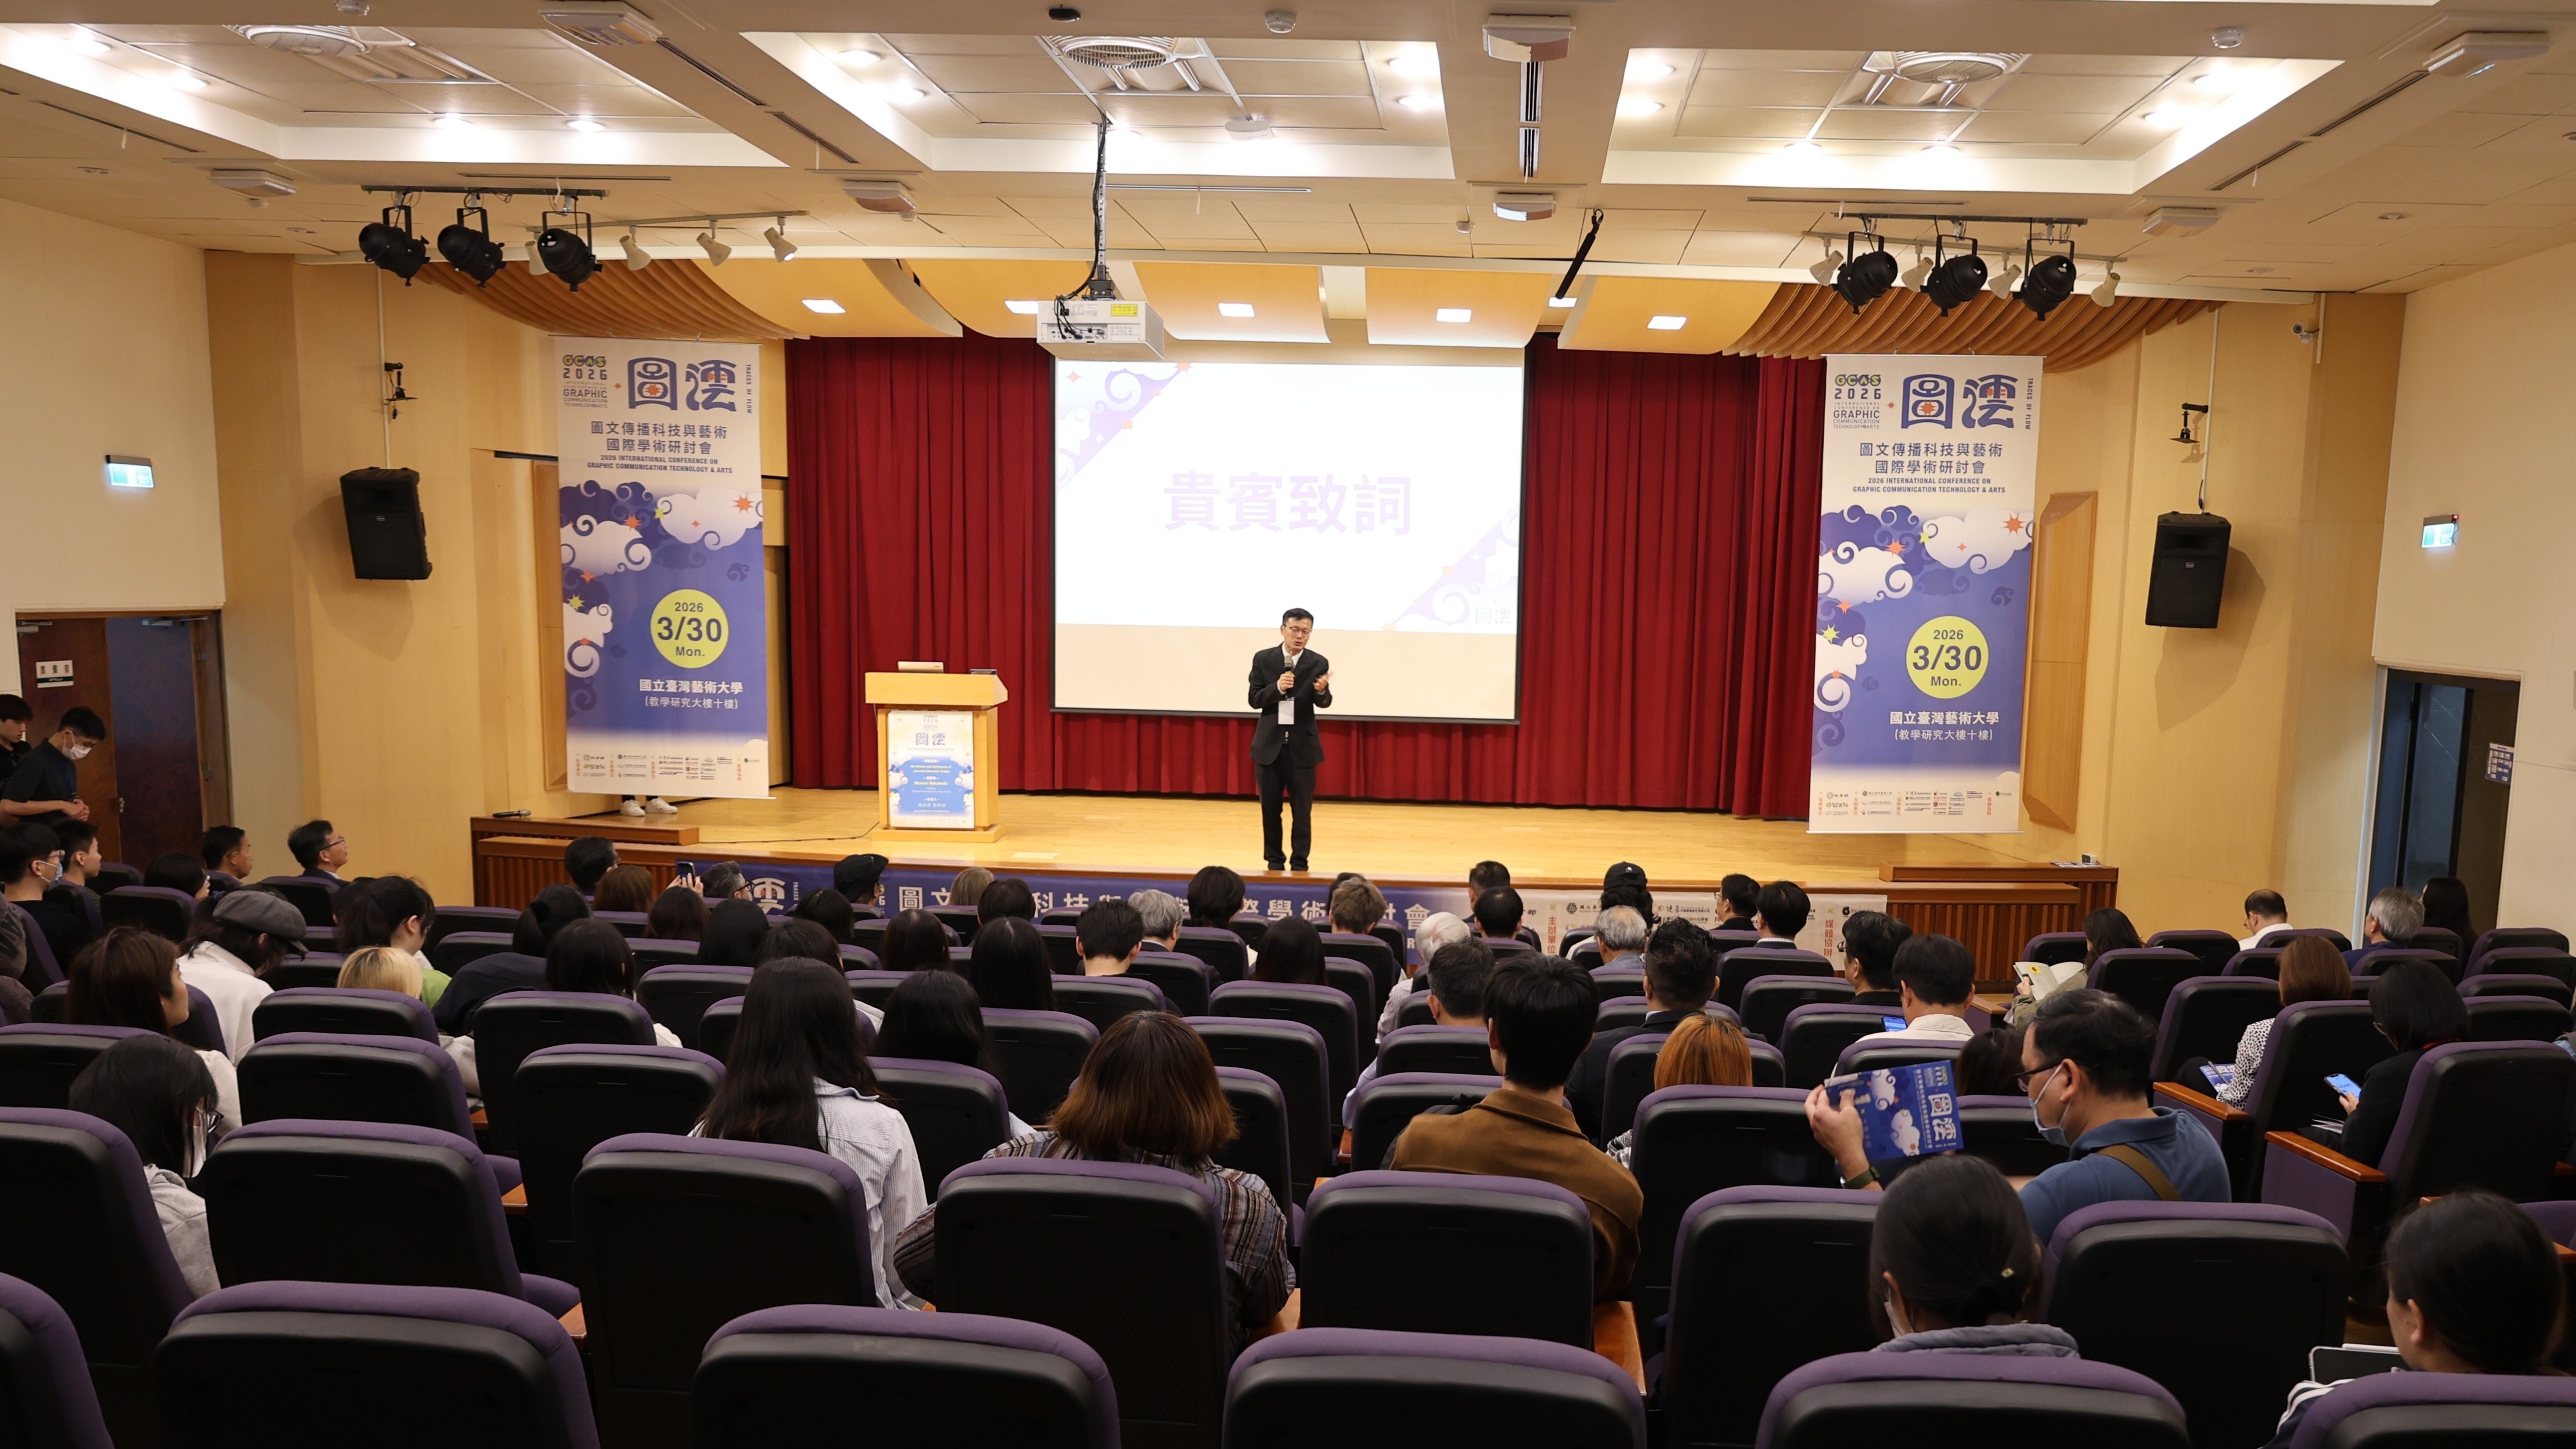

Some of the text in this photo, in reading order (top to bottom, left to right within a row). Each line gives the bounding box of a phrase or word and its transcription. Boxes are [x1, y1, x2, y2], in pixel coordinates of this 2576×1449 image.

[562, 355, 606, 367] GCAS
[563, 368, 607, 380] 2026
[1835, 374, 1881, 386] GCAS
[563, 389, 608, 398] GRAPHIC
[1834, 388, 1881, 399] 2026
[1833, 410, 1880, 418] GRAPHIC
[591, 421, 727, 439] 圖文傳播科技與藝術
[607, 438, 712, 454] 國際學術研討會
[1860, 443, 2002, 457] 圖文傳播科技與藝術
[1875, 460, 1985, 474] 國際學術研討會
[1164, 471, 1411, 535] 貴賓致詞
[675, 602, 703, 612] 2026
[657, 617, 722, 642] 3/30
[1933, 630, 1963, 640] 2026
[676, 647, 705, 656] Mon.
[1913, 645, 1981, 670] 3/30
[640, 679, 743, 694] 國立臺灣藝術大學
[1931, 676, 1961, 686] Mon.
[1890, 711, 1999, 725] 國立臺灣藝術大學
[1895, 729, 1992, 740] (教學研究大樓十樓)
[1547, 916, 1556, 954] 主辦單位
[1824, 919, 1834, 957] 媒體協辦
